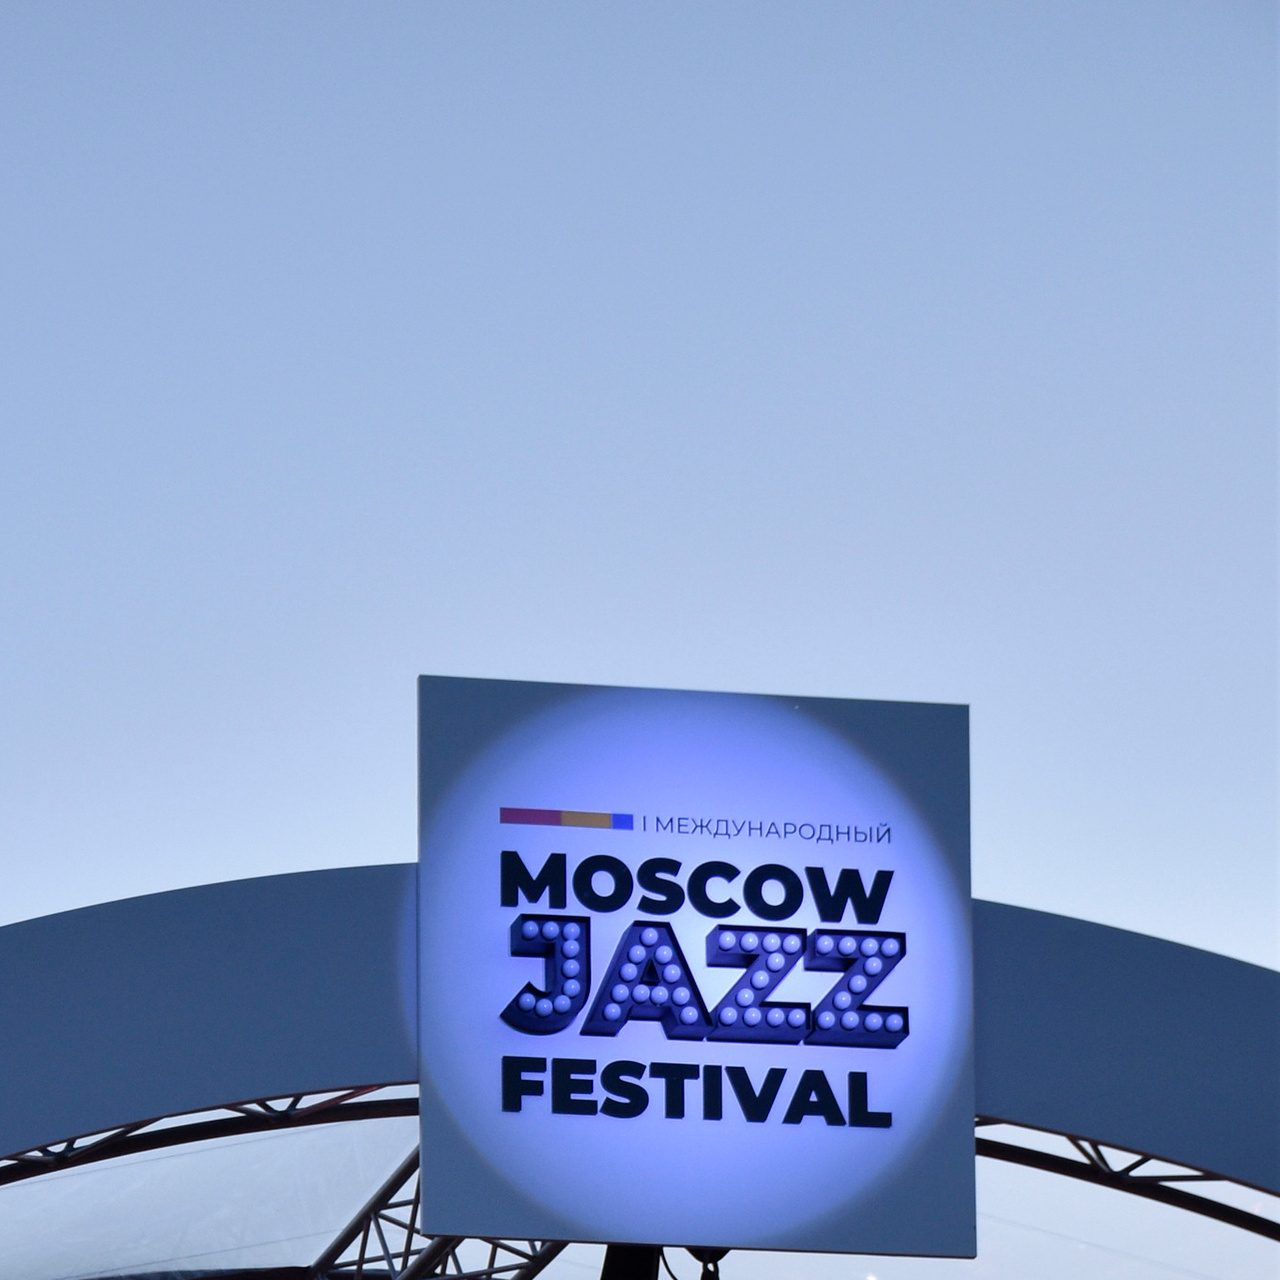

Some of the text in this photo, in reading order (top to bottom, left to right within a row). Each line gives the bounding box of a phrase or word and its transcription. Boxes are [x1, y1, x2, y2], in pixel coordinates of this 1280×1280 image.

[655, 816, 892, 844] МЕЖДУНАРОДНЫЙ
[500, 850, 895, 925] MOSCOW
[499, 913, 910, 1049] JAZZ
[501, 1055, 893, 1128] FESTIVAL
